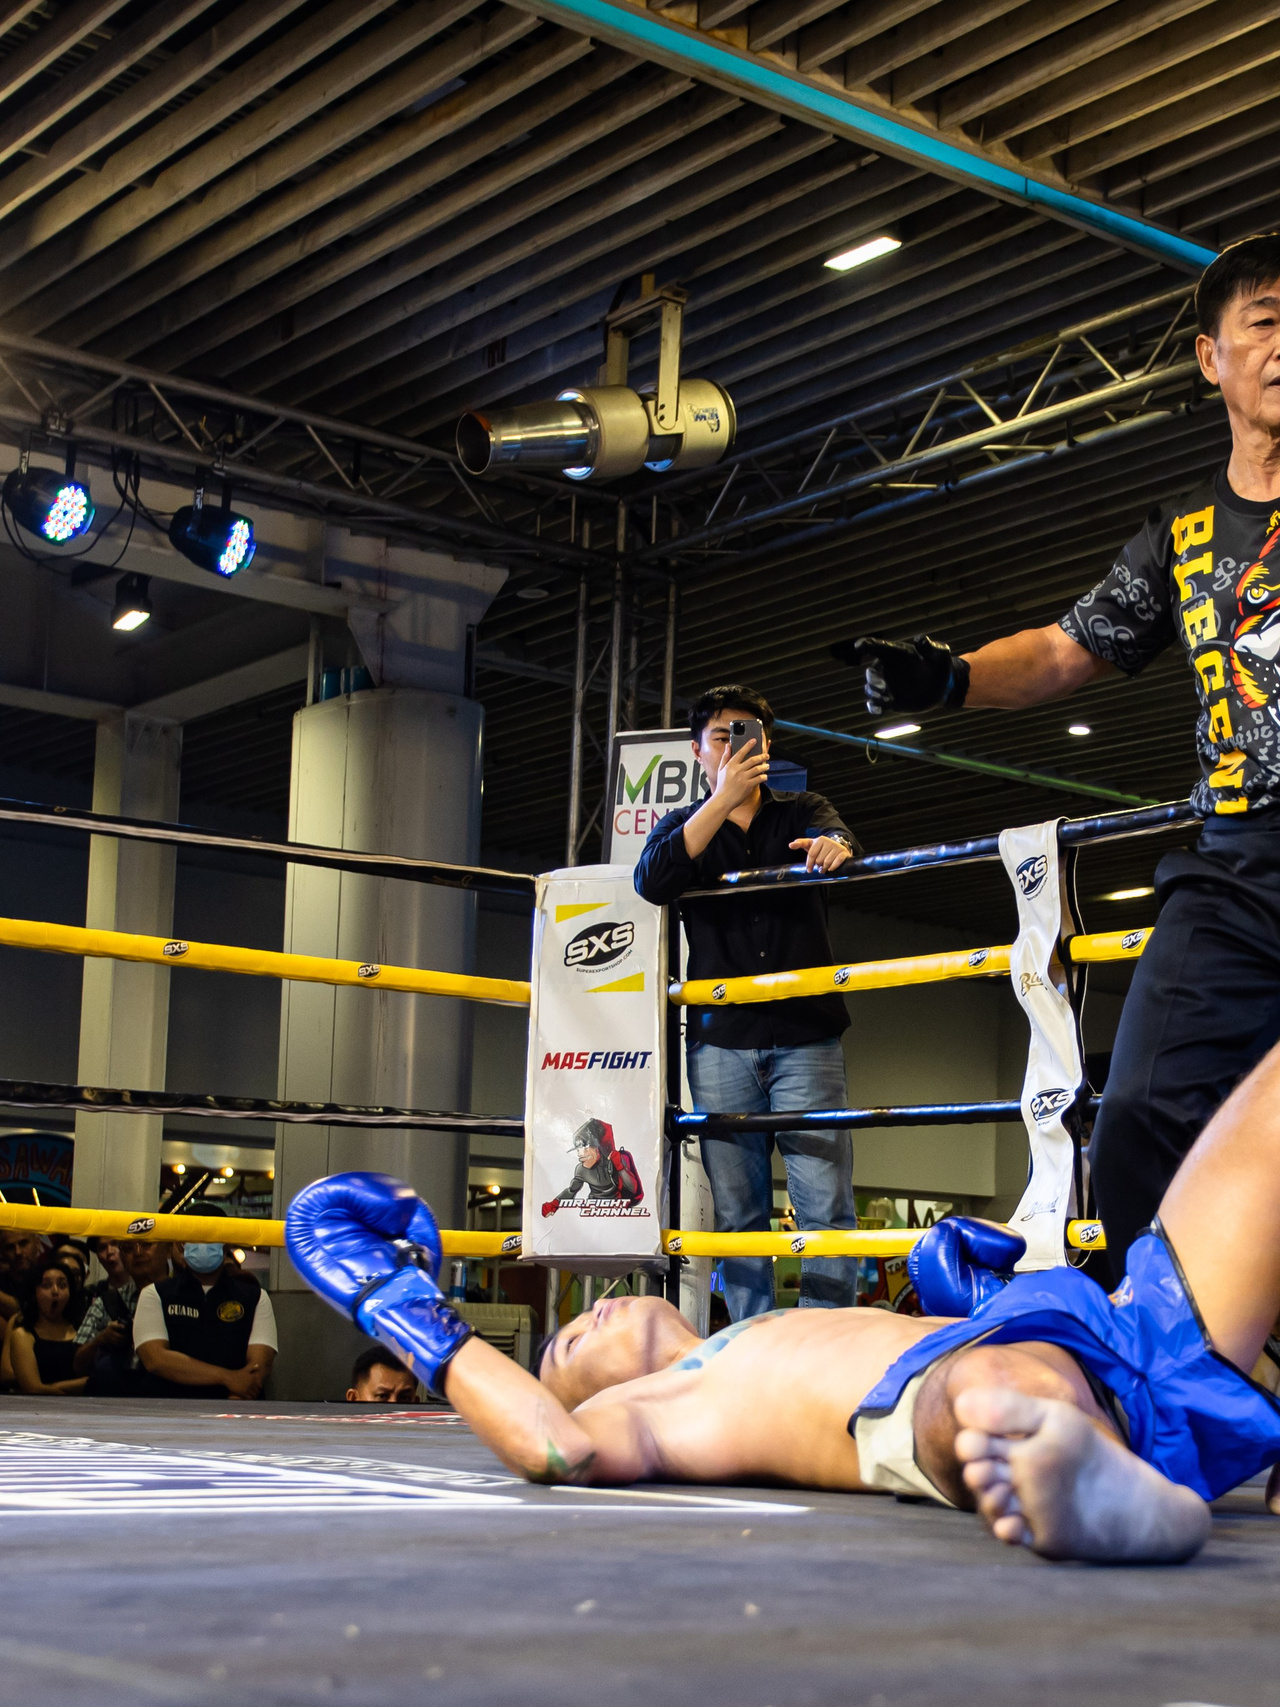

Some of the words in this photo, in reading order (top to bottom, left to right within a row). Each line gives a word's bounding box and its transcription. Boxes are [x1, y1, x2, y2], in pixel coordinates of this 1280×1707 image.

[614, 808, 682, 835] CEN
[564, 921, 635, 967] SXS
[1122, 930, 1146, 949] SXS
[163, 942, 189, 956] SXS
[576, 949, 633, 974] SUPEREXPORTSHOP.COM
[969, 949, 989, 967] SXS
[358, 964, 381, 978] SXS
[834, 967, 851, 985] SXS
[712, 984, 727, 1000] SXS
[541, 1052, 652, 1070] MASFIGHT
[559, 1198, 632, 1208] MR.FIGHT
[580, 1207, 651, 1218] CHANNEL
[127, 1219, 155, 1234] SXS
[1080, 1224, 1102, 1243] SXS
[791, 1237, 806, 1253] SXS
[168, 1304, 199, 1318] GUARD
